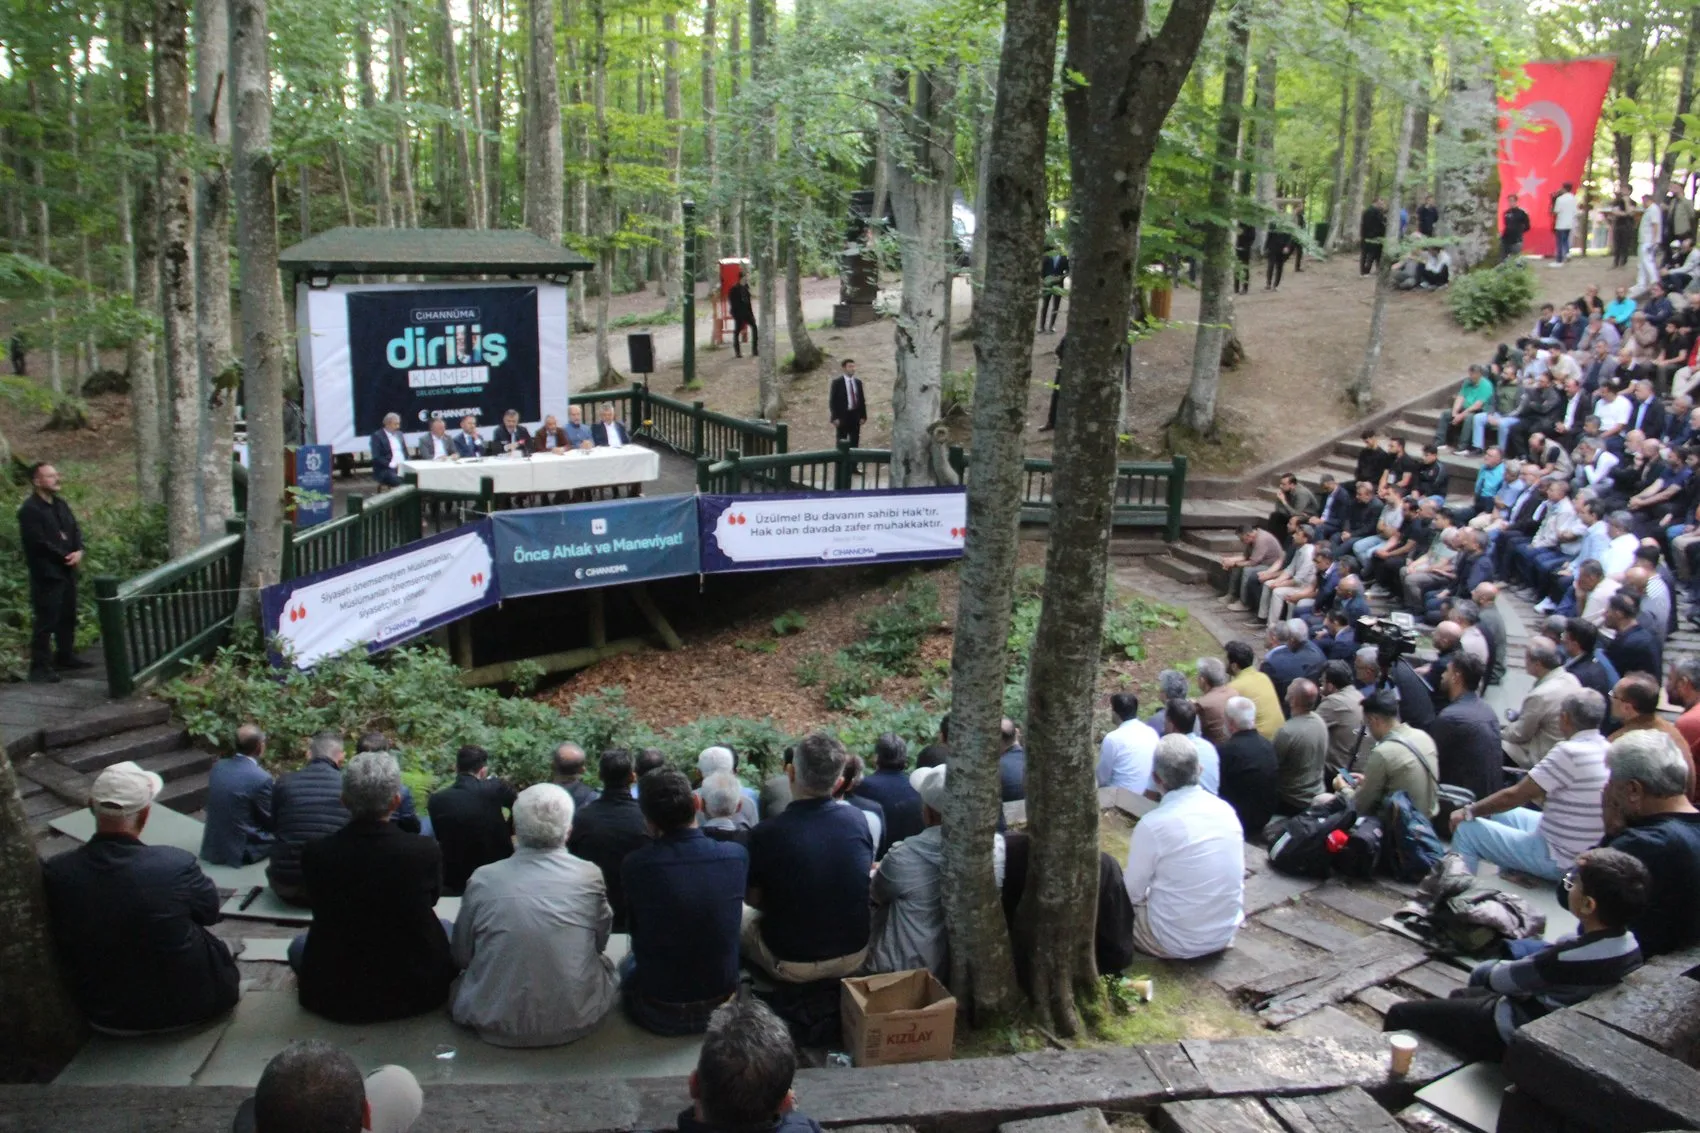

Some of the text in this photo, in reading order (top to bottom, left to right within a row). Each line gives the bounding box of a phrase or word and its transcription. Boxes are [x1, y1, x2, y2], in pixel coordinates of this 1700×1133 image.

[386, 323, 507, 369] diriliş
[803, 512, 819, 522] Bu
[822, 511, 864, 521] davanın
[867, 509, 899, 519] sahibi
[750, 527, 773, 537] Hak
[775, 526, 799, 536] olan
[802, 524, 841, 534] davada
[844, 523, 871, 532] zafer
[514, 531, 684, 563] Önce Ahlak ve Maneviyat!
[321, 584, 352, 604] Siyaseti
[353, 568, 406, 592] önemsemeyen
[391, 569, 441, 593] önemsemeyen
[887, 1030, 933, 1045] KIZILAY
